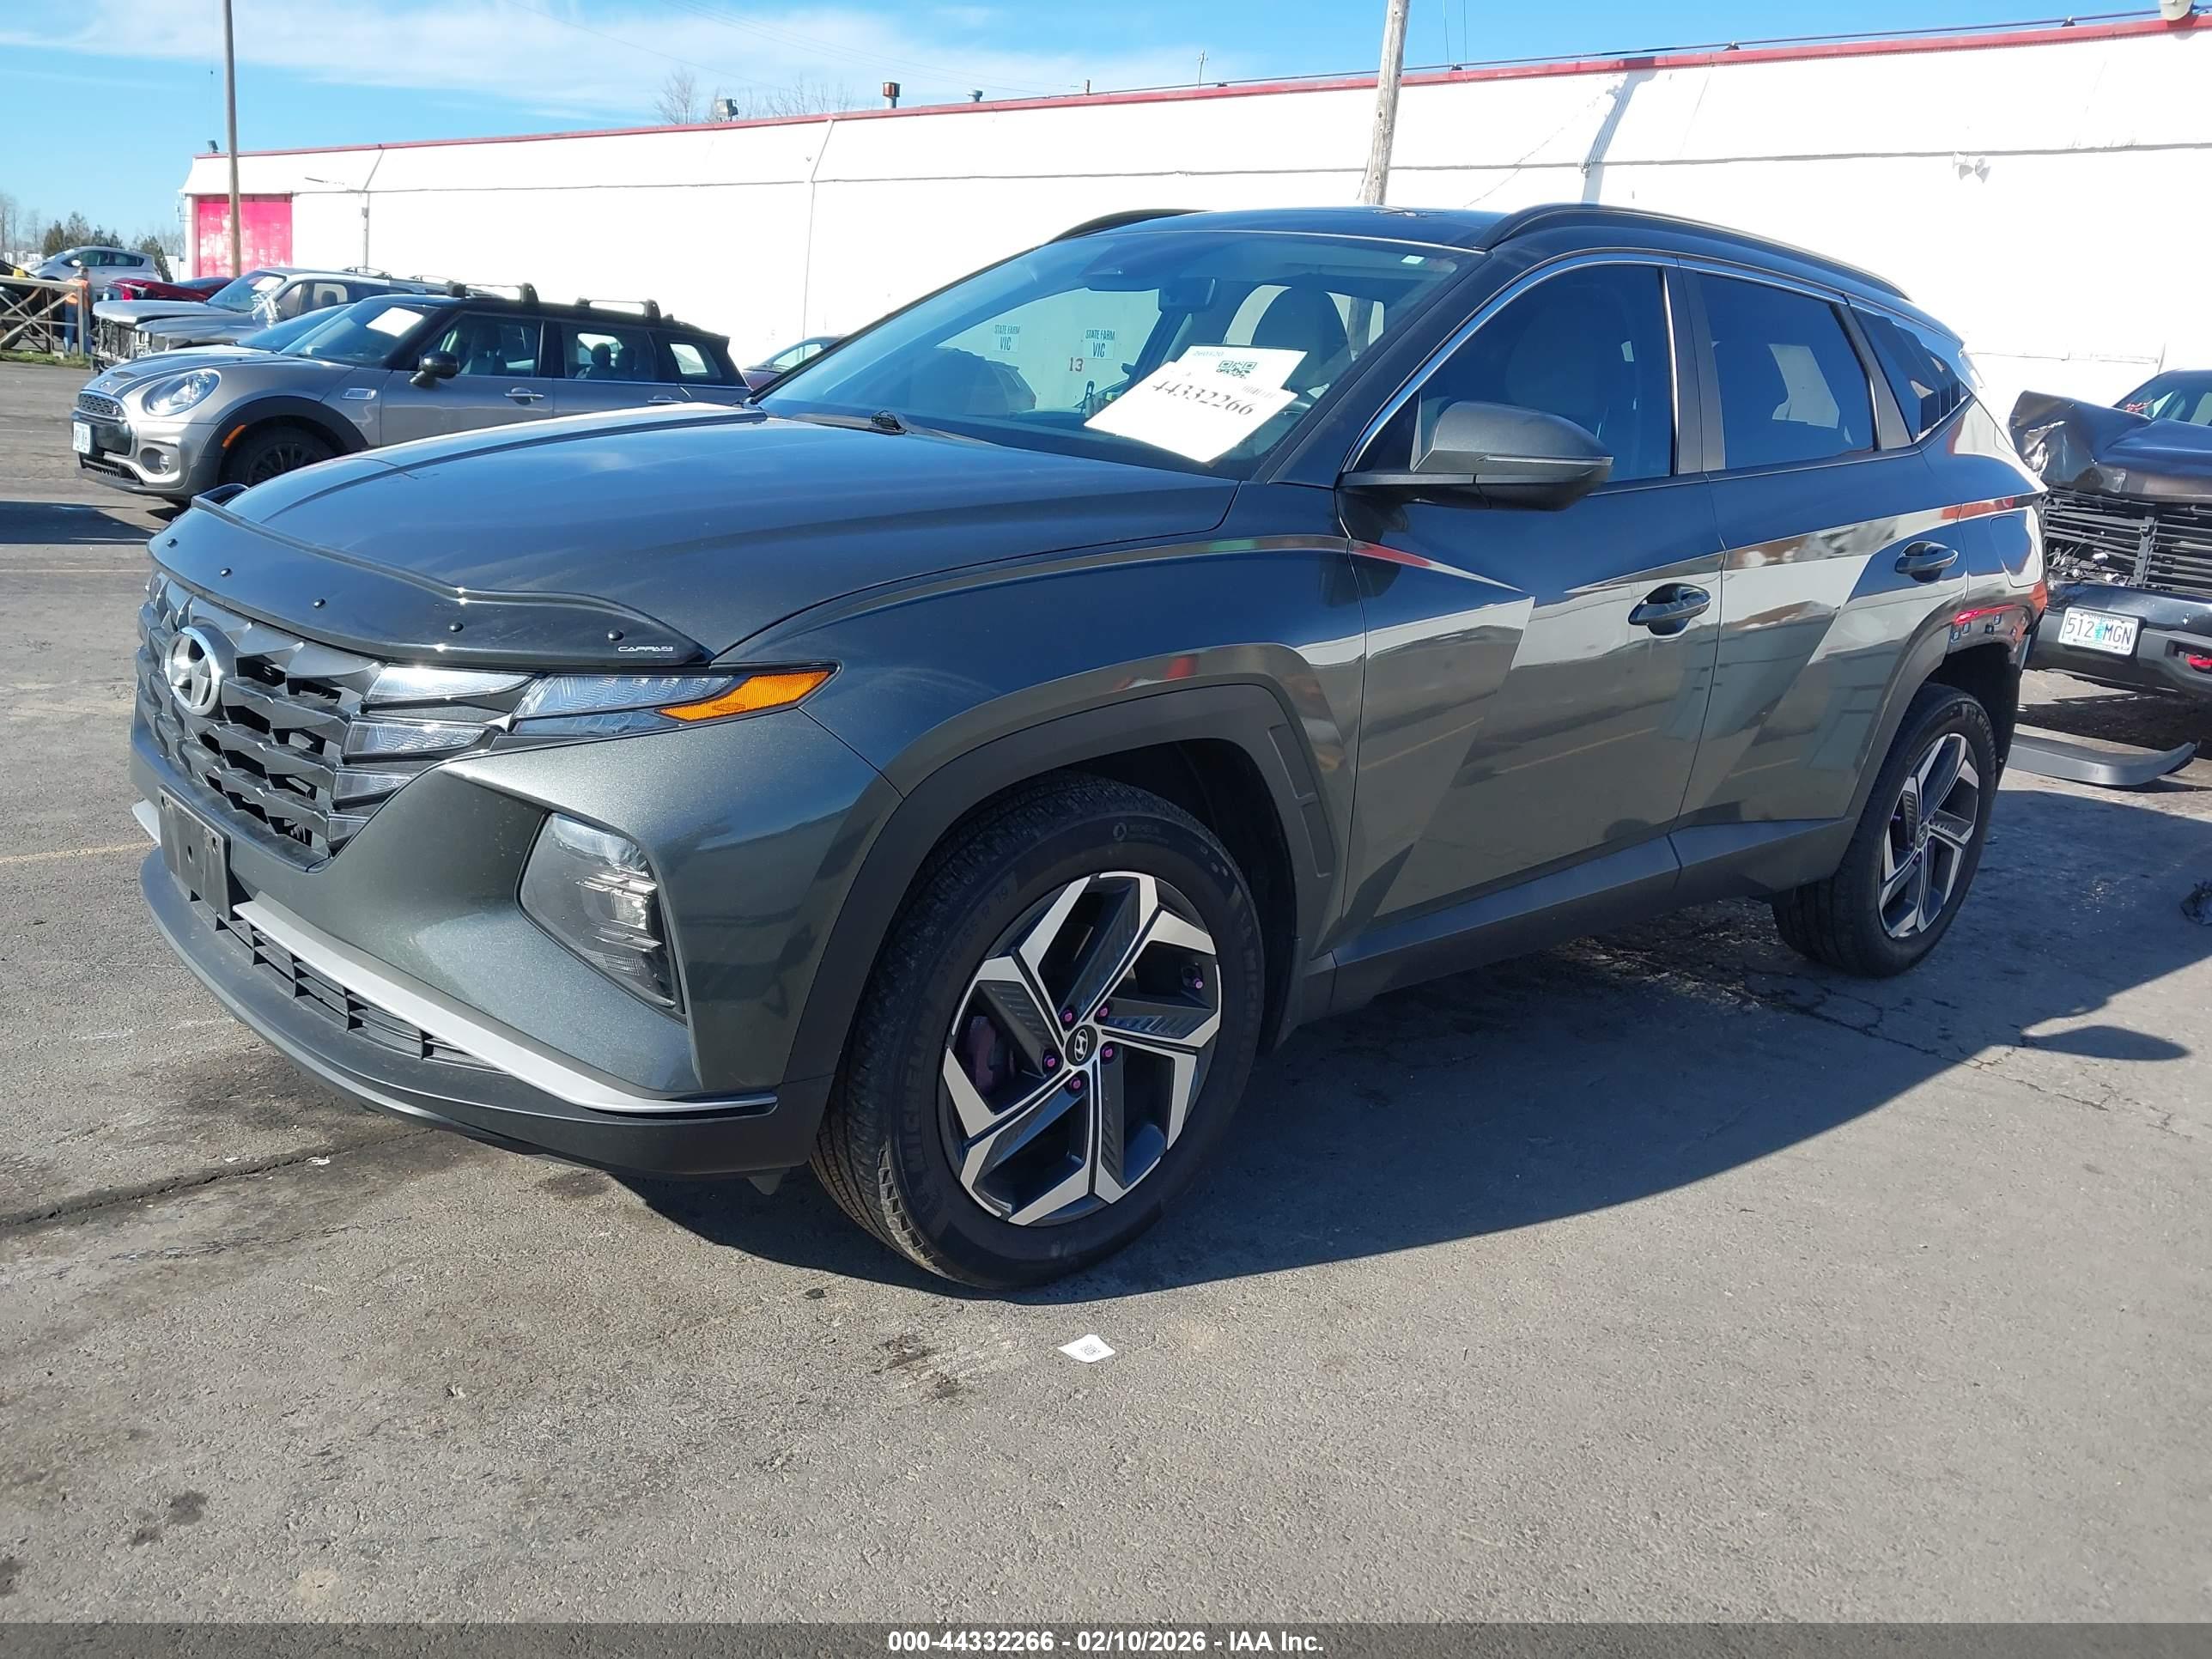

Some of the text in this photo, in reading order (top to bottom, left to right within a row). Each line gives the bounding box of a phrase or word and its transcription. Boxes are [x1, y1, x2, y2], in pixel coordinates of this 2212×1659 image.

[1085, 329, 1115, 341] STATE FARM
[1000, 336, 1012, 351] VIC
[1092, 342, 1106, 358] VIC
[1069, 356, 1084, 372] 13
[1152, 380, 1257, 416] 44332266
[2066, 617, 2133, 645] 512 MGN
